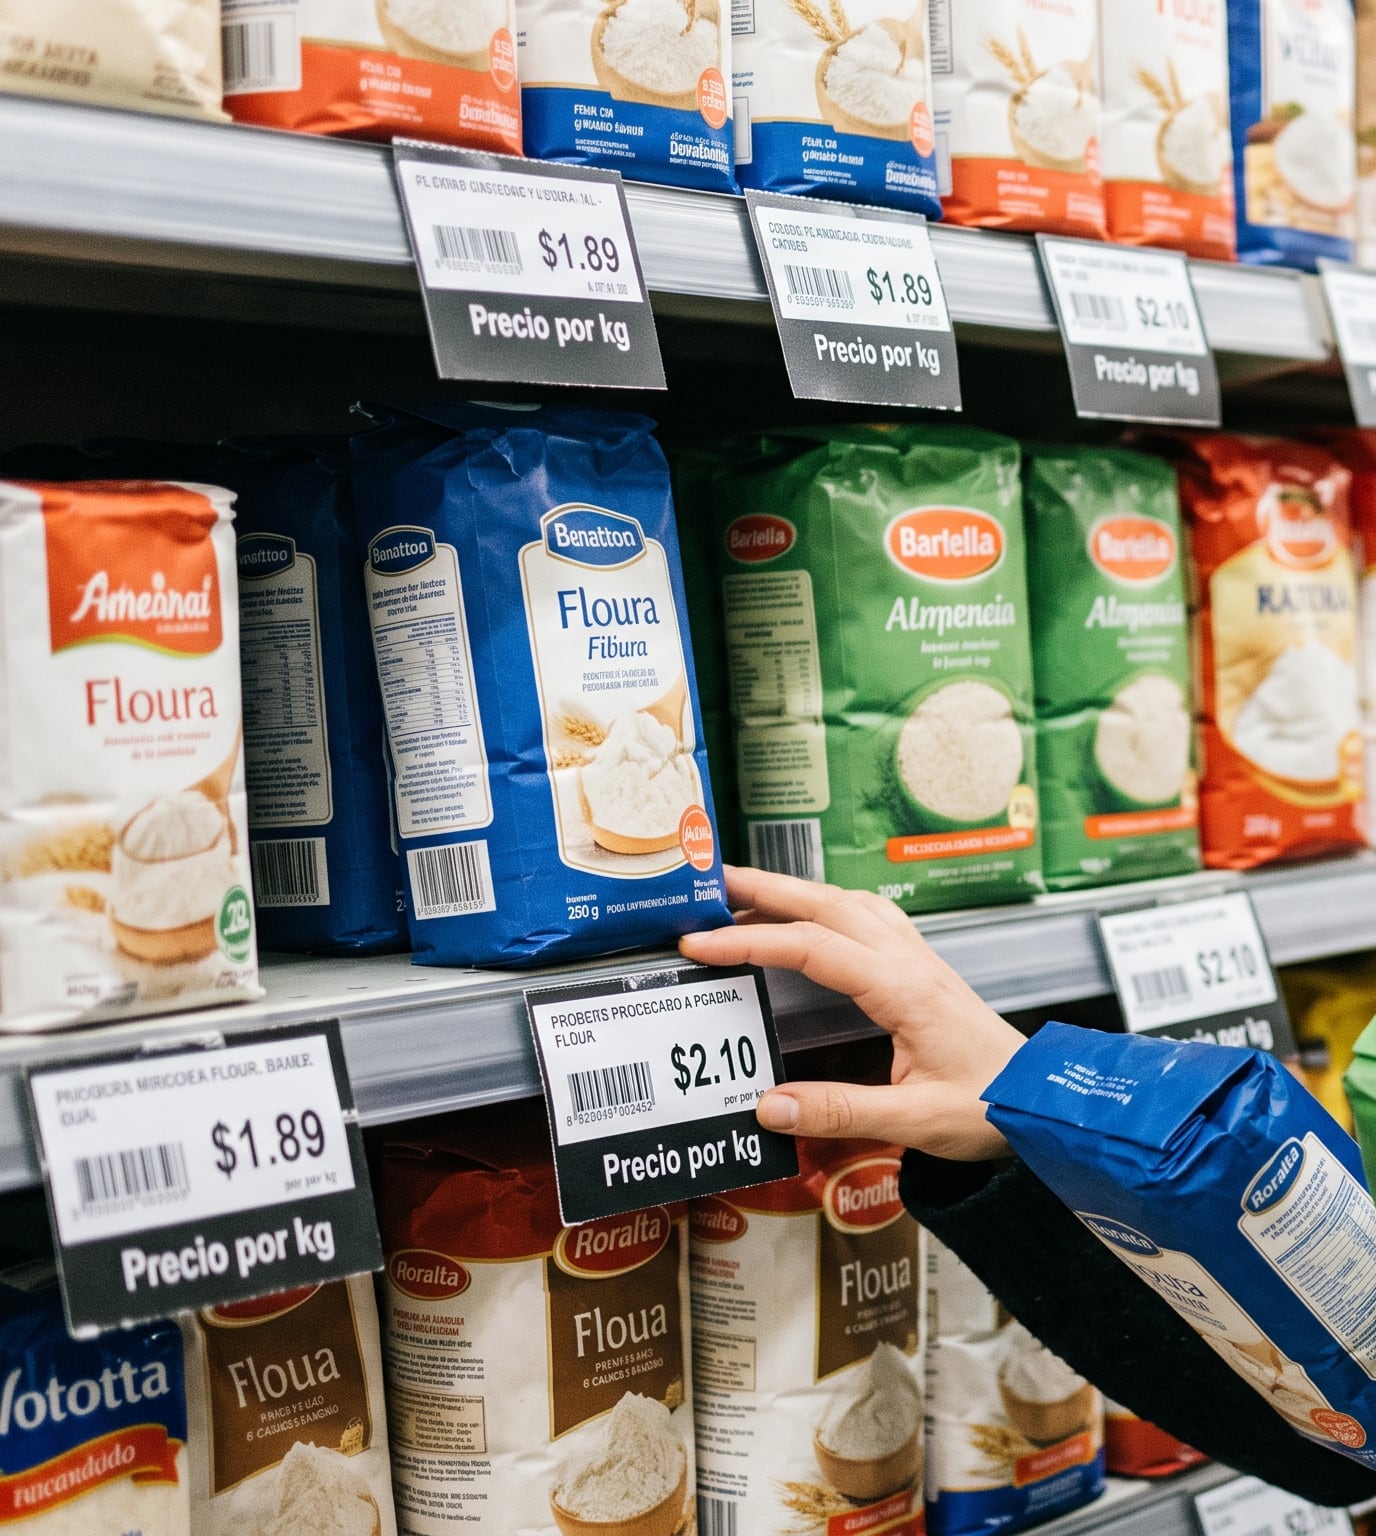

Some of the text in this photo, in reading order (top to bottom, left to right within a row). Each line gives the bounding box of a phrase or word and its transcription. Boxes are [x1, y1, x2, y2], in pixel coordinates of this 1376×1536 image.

[538, 228, 620, 273] $1.89
[867, 266, 932, 306] $1.89
[469, 303, 630, 351] Precio por kg
[1136, 295, 1189, 331] $2.10
[814, 333, 941, 376] Precio por kg
[1094, 354, 1147, 386] Precio
[1148, 364, 1175, 392] por
[557, 586, 660, 629] Floura
[85, 675, 218, 727] Floura
[568, 905, 599, 920] 250 g
[1197, 944, 1257, 986] $2.10
[685, 996, 693, 1009] A
[555, 1030, 596, 1048] FLOUR
[670, 1035, 757, 1096] $2.10
[724, 1095, 738, 1107] por
[740, 1092, 753, 1104] por
[211, 1108, 326, 1181] $1.89
[603, 1130, 762, 1188] Precio por kg
[121, 1217, 336, 1292] Precio por kg
[575, 1213, 662, 1260] Roralta
[397, 1260, 459, 1287] Roralta
[841, 1257, 911, 1306] Floua
[574, 1304, 667, 1358] Floua
[227, 1347, 341, 1408] Floua
